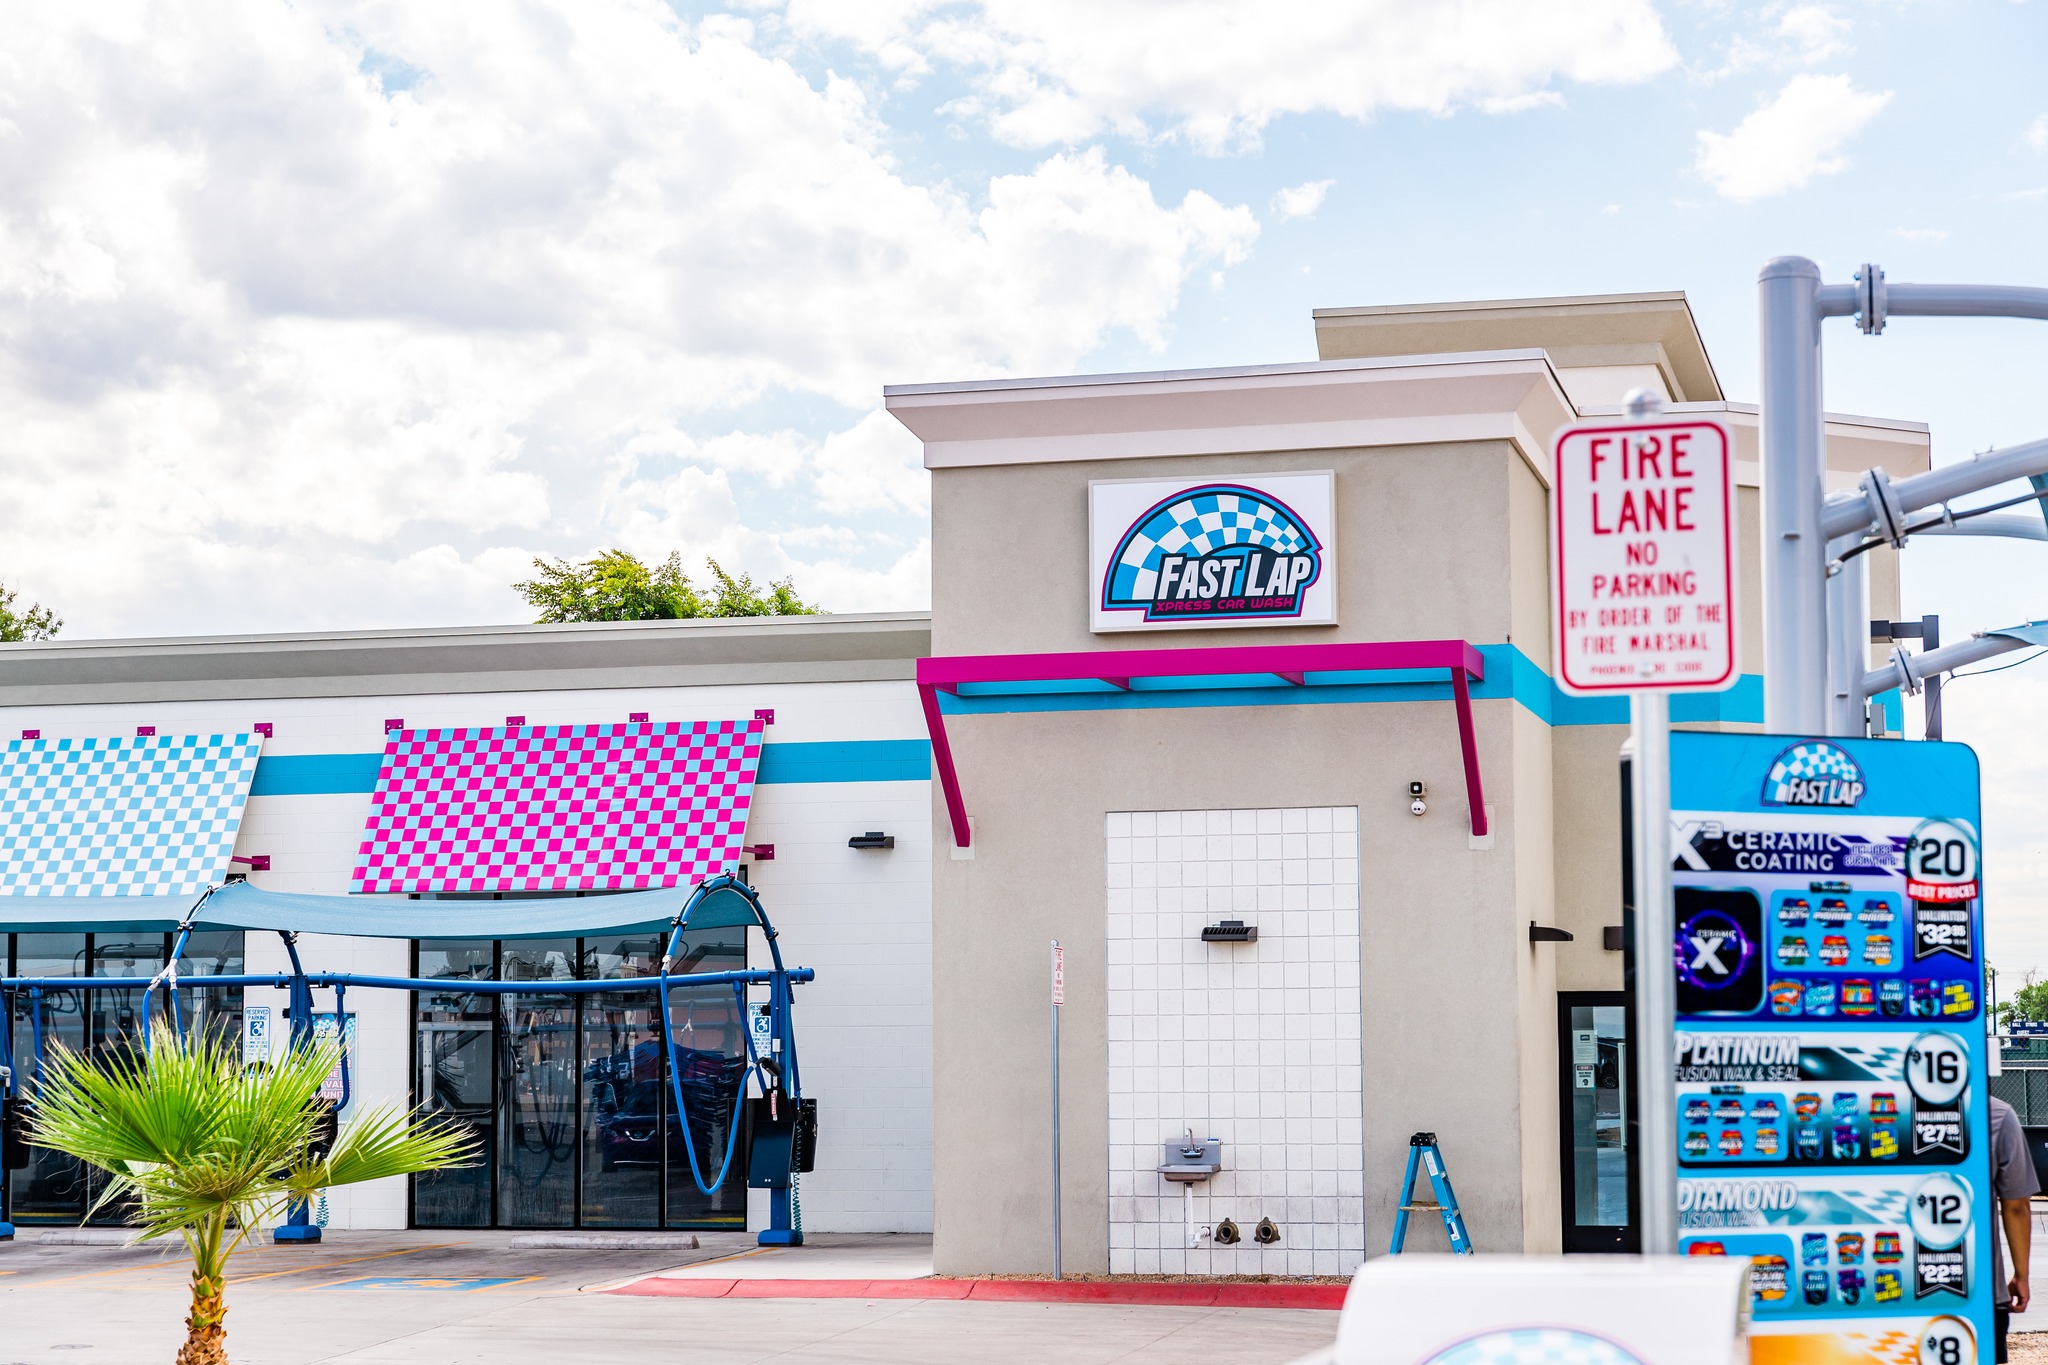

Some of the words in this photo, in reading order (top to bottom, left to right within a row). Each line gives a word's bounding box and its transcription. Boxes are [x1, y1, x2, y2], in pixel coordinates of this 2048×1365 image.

[1590, 434, 1694, 482] FIRE
[1592, 487, 1696, 536] LANE
[1625, 540, 1658, 567] NO
[1157, 556, 1241, 600] FAST
[1245, 553, 1311, 597] LAP
[1592, 570, 1697, 600] PARKING
[1155, 600, 1212, 612] XPRESS
[1217, 599, 1246, 610] CAR
[1250, 597, 1293, 609] WASH
[1569, 609, 1589, 629] BY
[1598, 606, 1652, 627] ORDER
[1665, 604, 1684, 625] OF
[1696, 602, 1723, 624] THE
[1582, 635, 1617, 655] FIRE
[1629, 632, 1711, 652] MARSHAL
[1787, 777, 1829, 804] FAST
[1828, 778, 1863, 805] LAP
[1726, 831, 1842, 852] CERAMIC
[1735, 851, 1834, 872] COATING
[1696, 929, 1737, 939] CERAMIC
[1689, 936, 1730, 975] X
[1674, 1034, 1800, 1066] PLATINUM
[1722, 1065, 1754, 1081] WAX
[1754, 1065, 1765, 1081] &
[1766, 1065, 1801, 1081] SEAL
[1677, 1180, 1798, 1212] DIAMOND
[1679, 1211, 1726, 1228] USION
